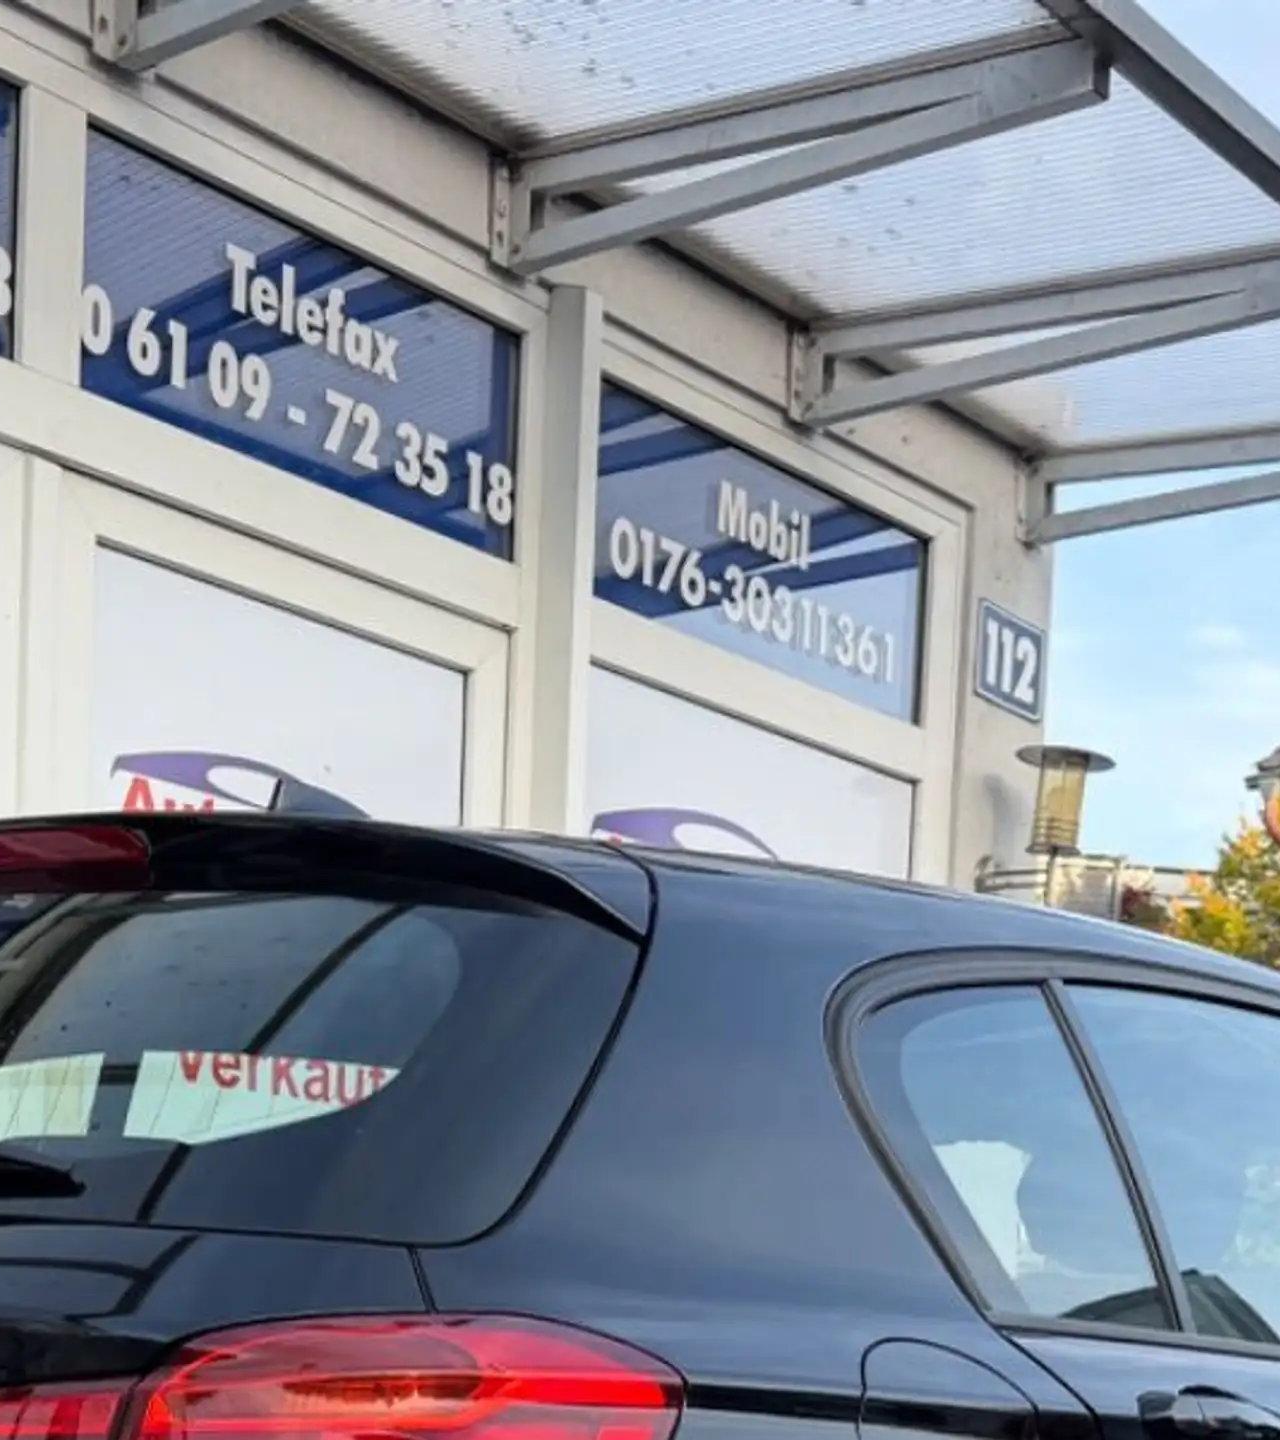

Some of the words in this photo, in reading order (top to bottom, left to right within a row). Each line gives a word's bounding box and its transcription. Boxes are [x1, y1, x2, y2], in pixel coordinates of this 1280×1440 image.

[225, 242, 401, 384] Telefax
[82, 284, 112, 355] 0
[127, 307, 187, 389] 61
[207, 340, 271, 422] 09
[322, 388, 381, 470] 72
[394, 421, 448, 496] 35
[465, 450, 512, 526] 18
[718, 480, 811, 571] Mobil
[608, 517, 896, 683] 0176-30311361
[983, 616, 1038, 700] 112
